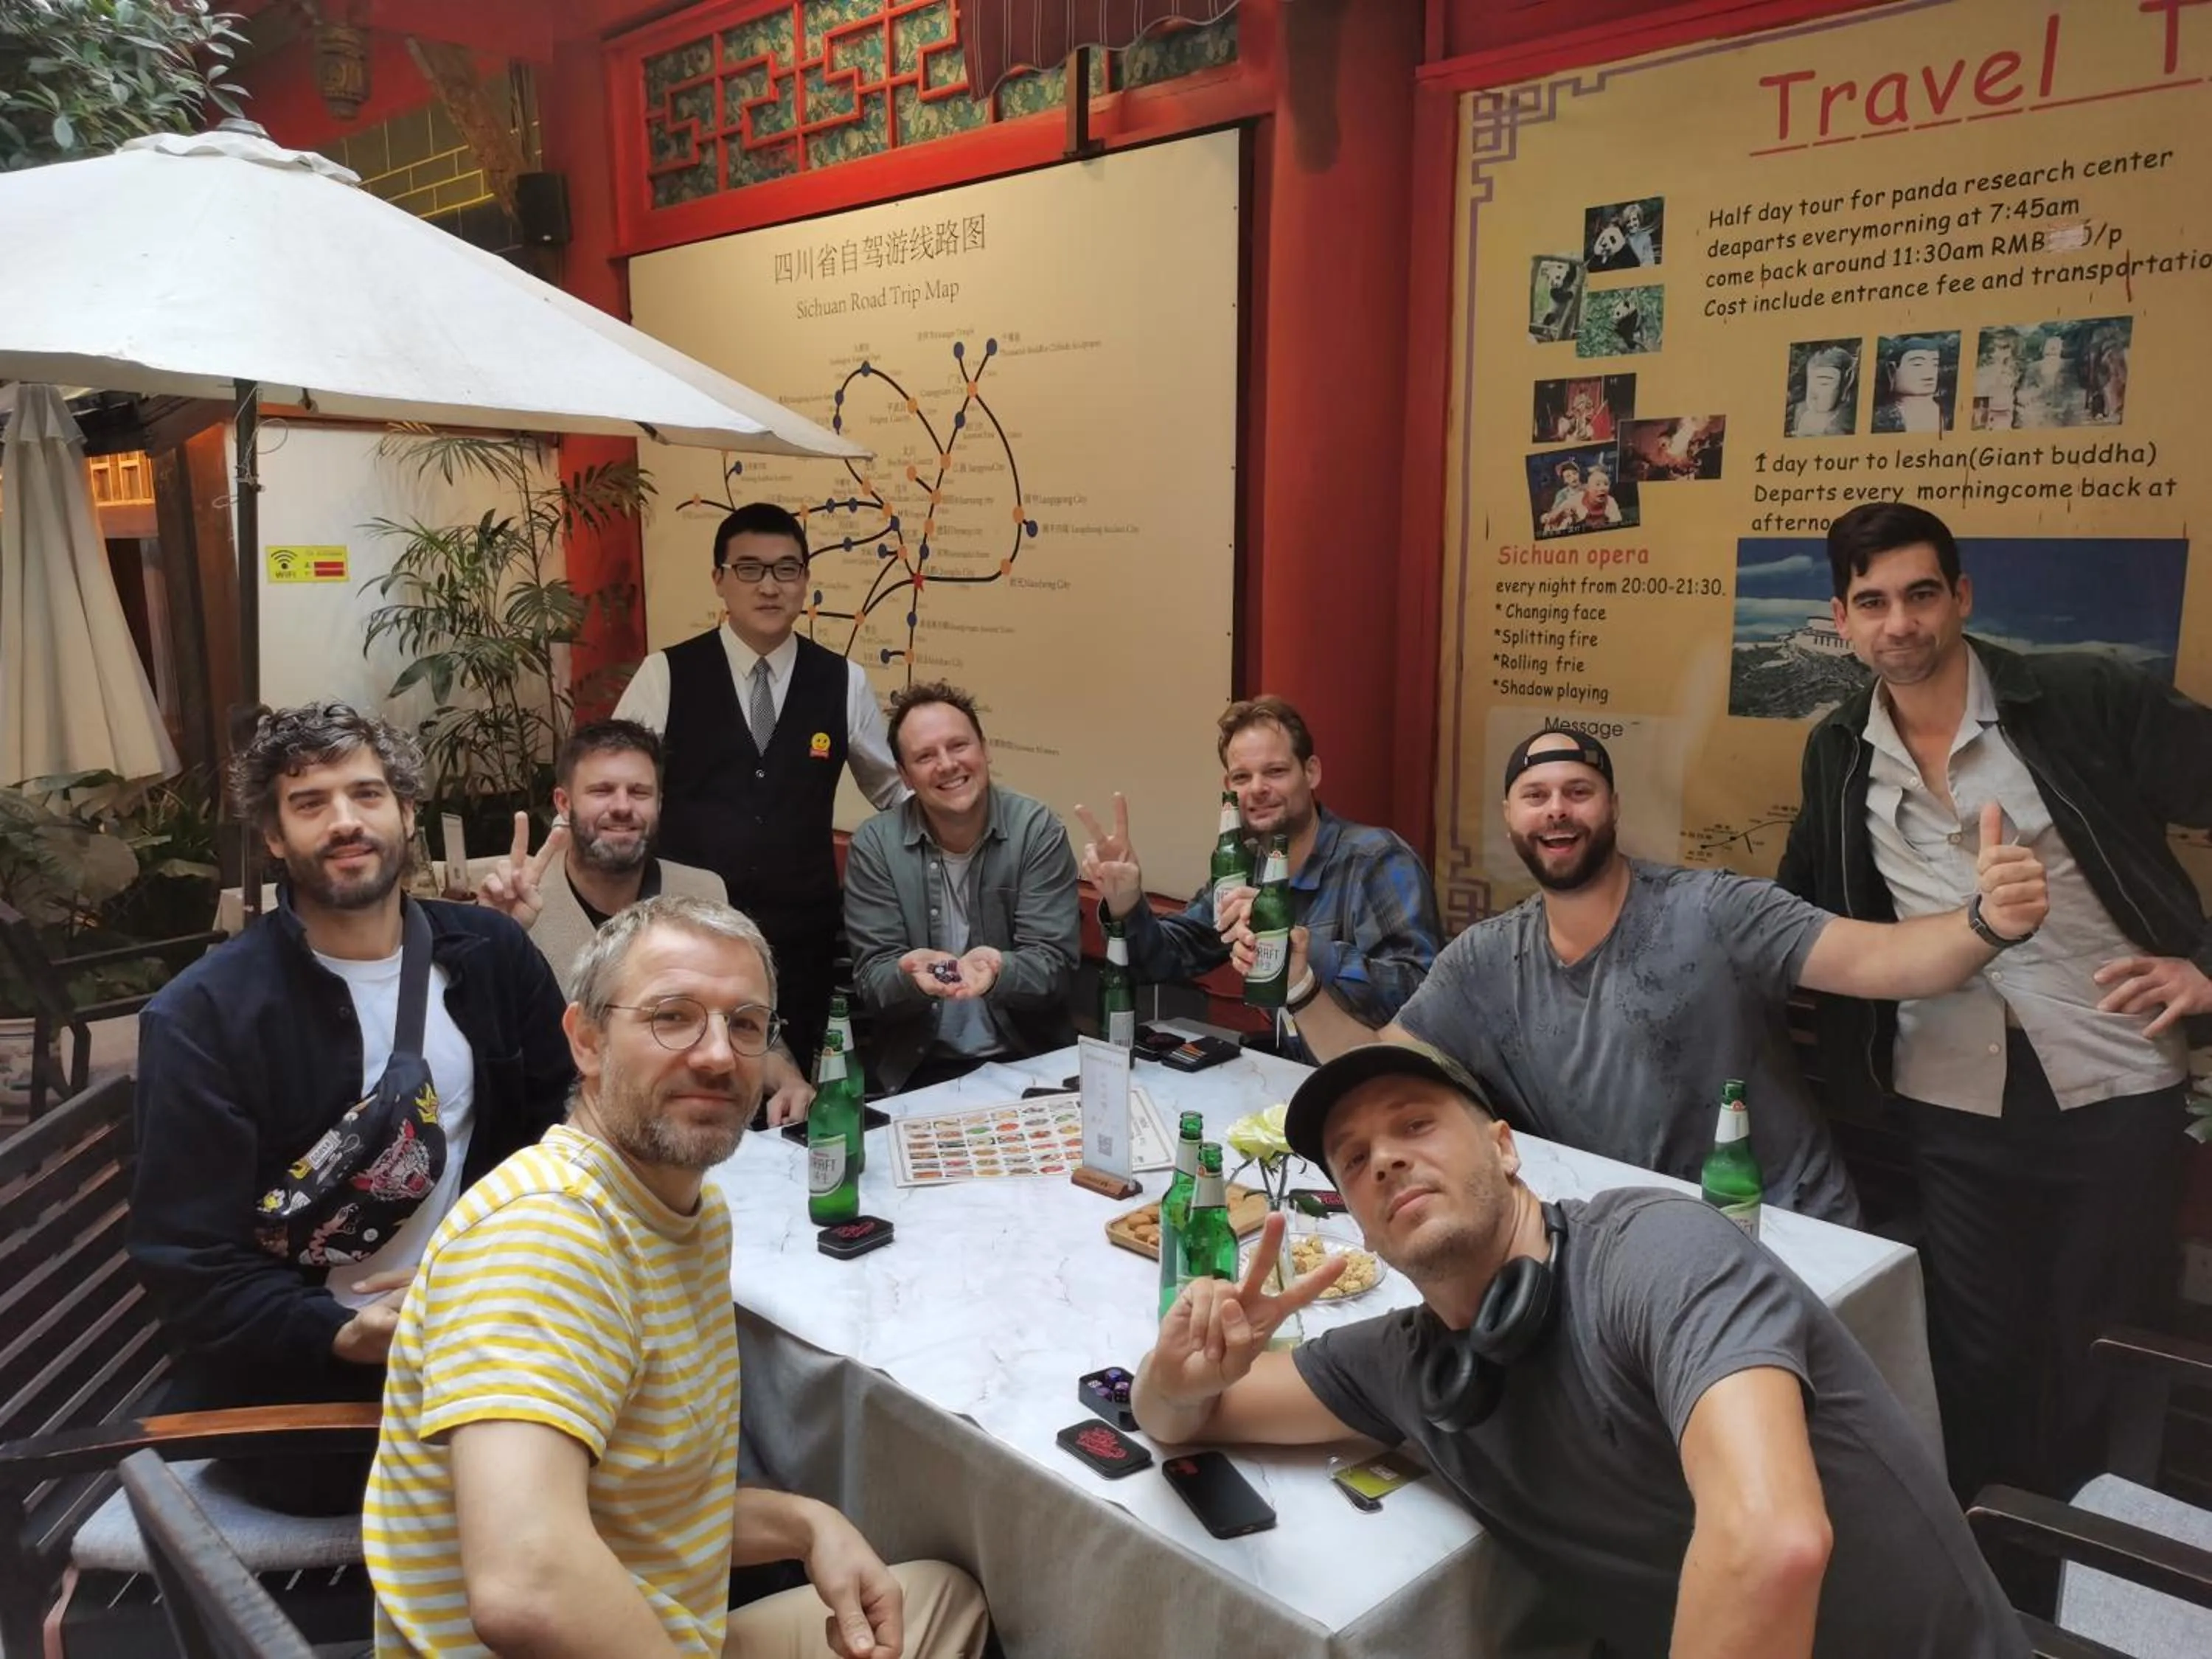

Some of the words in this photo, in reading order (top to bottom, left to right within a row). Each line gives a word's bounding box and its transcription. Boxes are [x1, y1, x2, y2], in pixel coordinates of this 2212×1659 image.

[1759, 14, 2059, 140] Travel
[1708, 204, 1753, 229] Half
[1758, 202, 1793, 223] day
[1798, 197, 1844, 216] tour
[1851, 189, 1885, 210] for
[1891, 177, 1957, 208] panda
[1964, 159, 2074, 193] research
[2083, 150, 2173, 178] center
[1708, 232, 1797, 259] deaparts
[1958, 207, 1982, 228] at
[1990, 198, 2079, 223] 7:45am
[774, 214, 985, 284] 四川省自驾游线路图
[1705, 270, 1754, 288] come
[1760, 259, 1807, 288] back
[1813, 249, 1886, 275] around
[1892, 241, 1983, 267] 11:30am
[797, 297, 846, 319] Sichuan
[851, 287, 886, 312] Road
[889, 285, 920, 308] Trip
[925, 279, 959, 304] Map
[1704, 297, 1747, 317] Cost
[1753, 288, 1826, 313] include
[1831, 279, 1928, 305] entrance
[1936, 274, 1975, 296] fee
[1982, 265, 2024, 290] and
[1755, 452, 1767, 473] 1
[1773, 454, 1807, 476] day
[1814, 455, 1859, 471] tour
[1866, 453, 1888, 470] to
[2052, 441, 2157, 467] buddha)
[1754, 484, 1837, 507] Departs
[1843, 486, 1904, 504] every
[2081, 476, 2141, 498] back
[2149, 478, 2177, 496] at
[1752, 512, 1832, 532] afterno
[1498, 546, 1579, 565] Sichuan
[1587, 549, 1649, 570] opera
[1496, 580, 1535, 596] every
[1539, 577, 1575, 597] night
[1580, 577, 1616, 594] from
[1506, 603, 1569, 624] Changing
[1573, 603, 1607, 620] face
[1570, 629, 1599, 647] fire
[1556, 655, 1585, 672] frie
[1557, 682, 1609, 705] playing
[1545, 717, 1624, 740] Message
[1256, 947, 1279, 959] RAFT
[811, 1157, 835, 1172] RAFT
